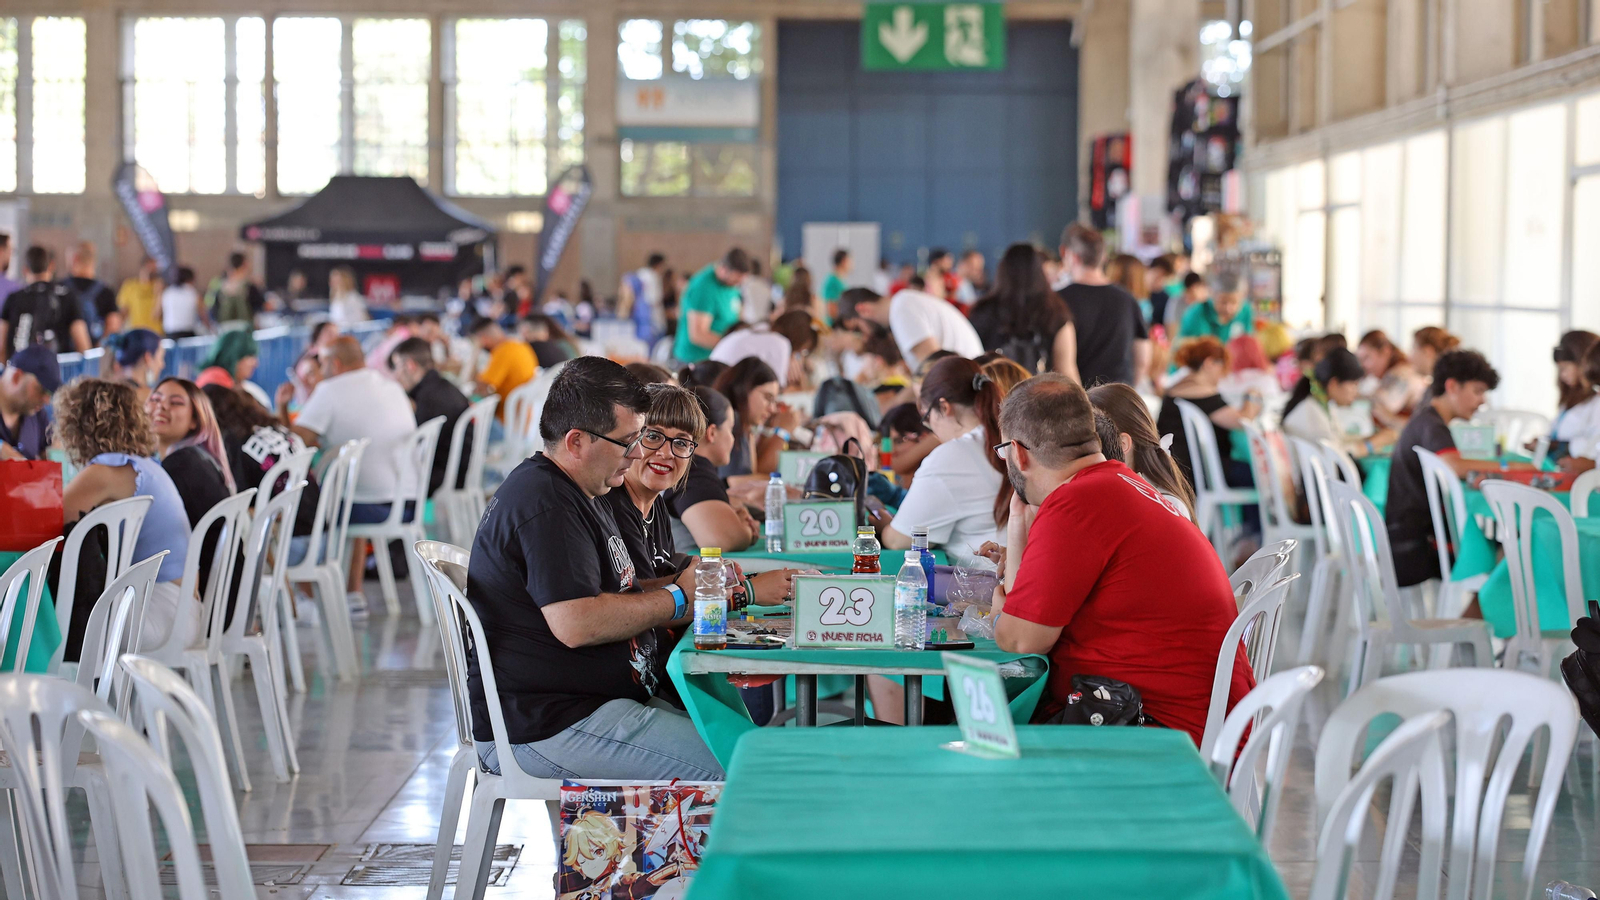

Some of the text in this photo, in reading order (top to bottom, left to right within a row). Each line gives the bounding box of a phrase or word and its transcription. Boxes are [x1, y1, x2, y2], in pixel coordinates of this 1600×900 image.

[799, 508, 841, 537] 20
[819, 586, 875, 626] 23
[856, 632, 884, 642] FICHA
[962, 674, 997, 725] 26
